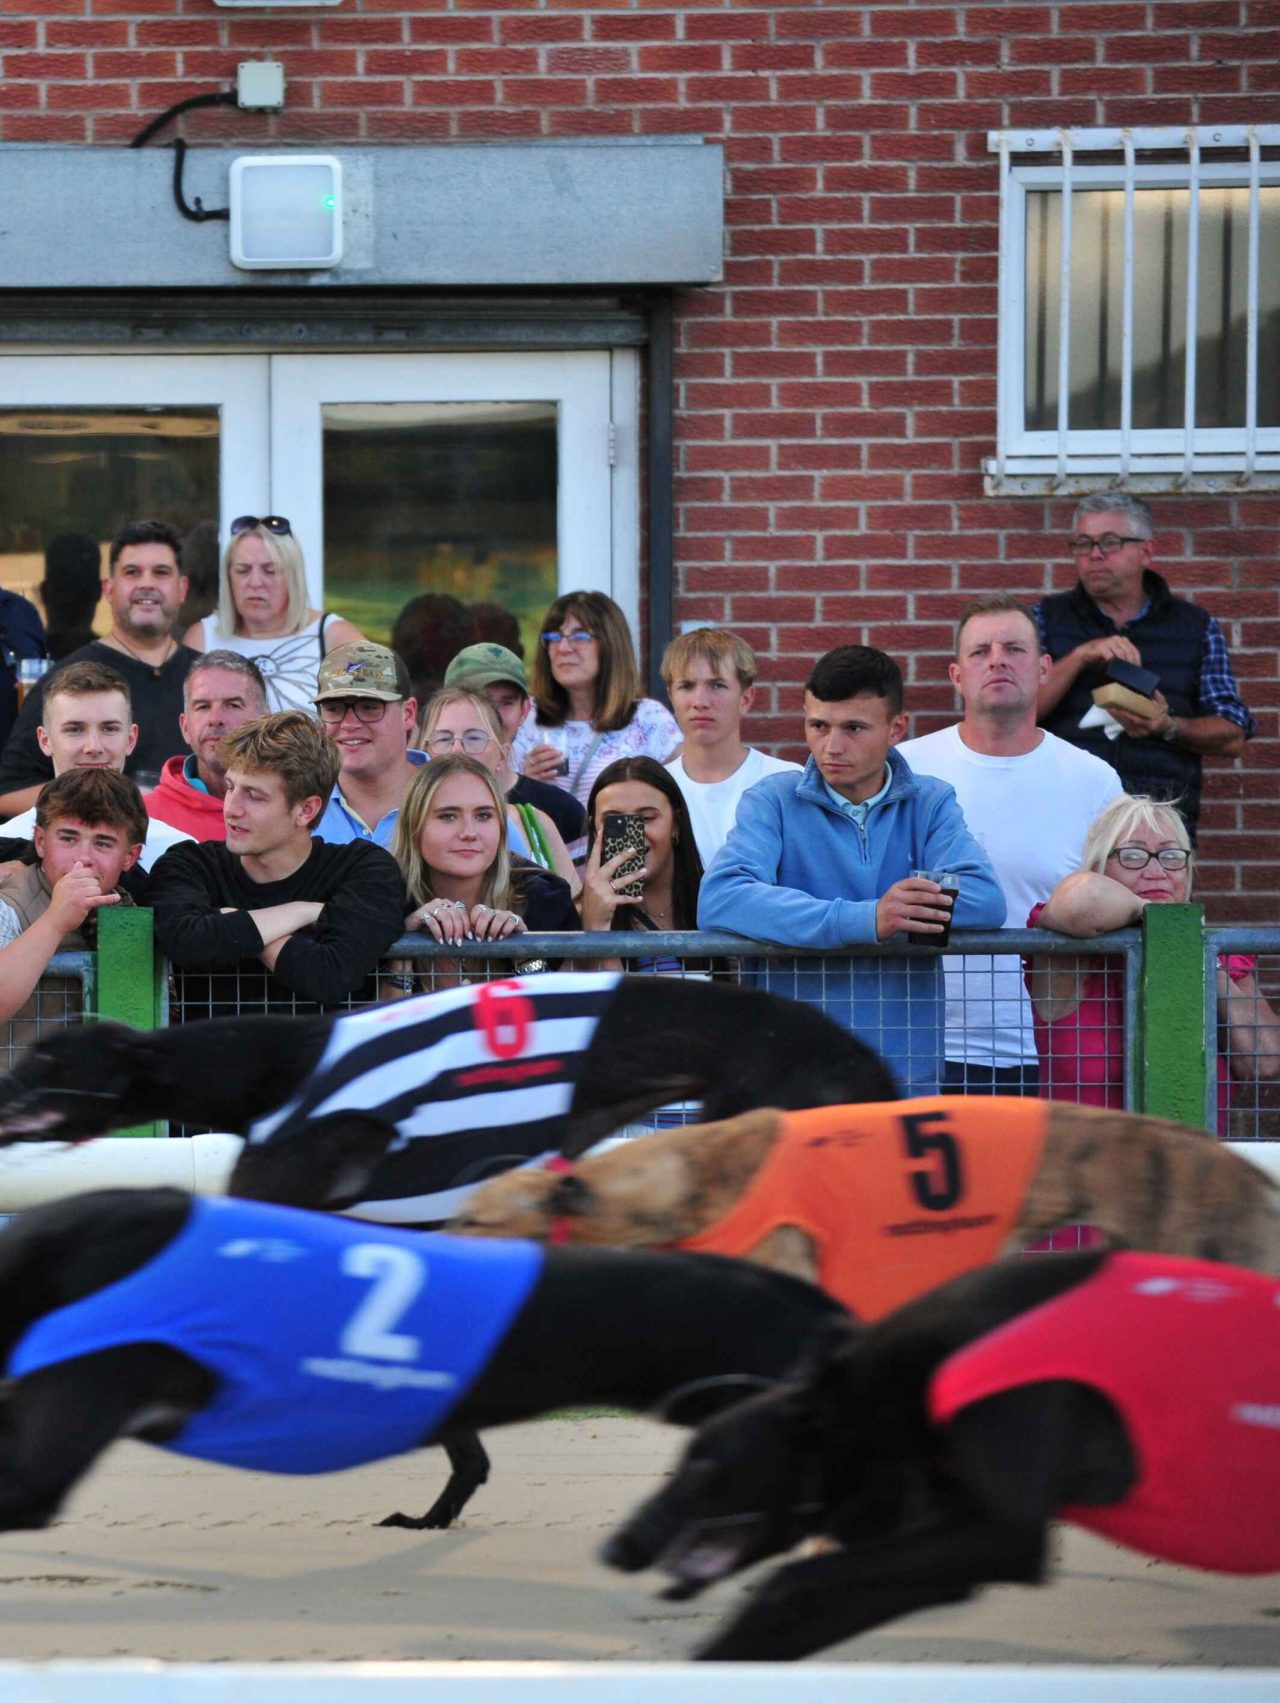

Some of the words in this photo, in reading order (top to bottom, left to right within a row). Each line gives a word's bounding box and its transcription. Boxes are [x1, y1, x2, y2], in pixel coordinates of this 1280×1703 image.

[474, 979, 534, 1060] 6
[899, 1111, 963, 1211] 5
[342, 1243, 426, 1361] 2
